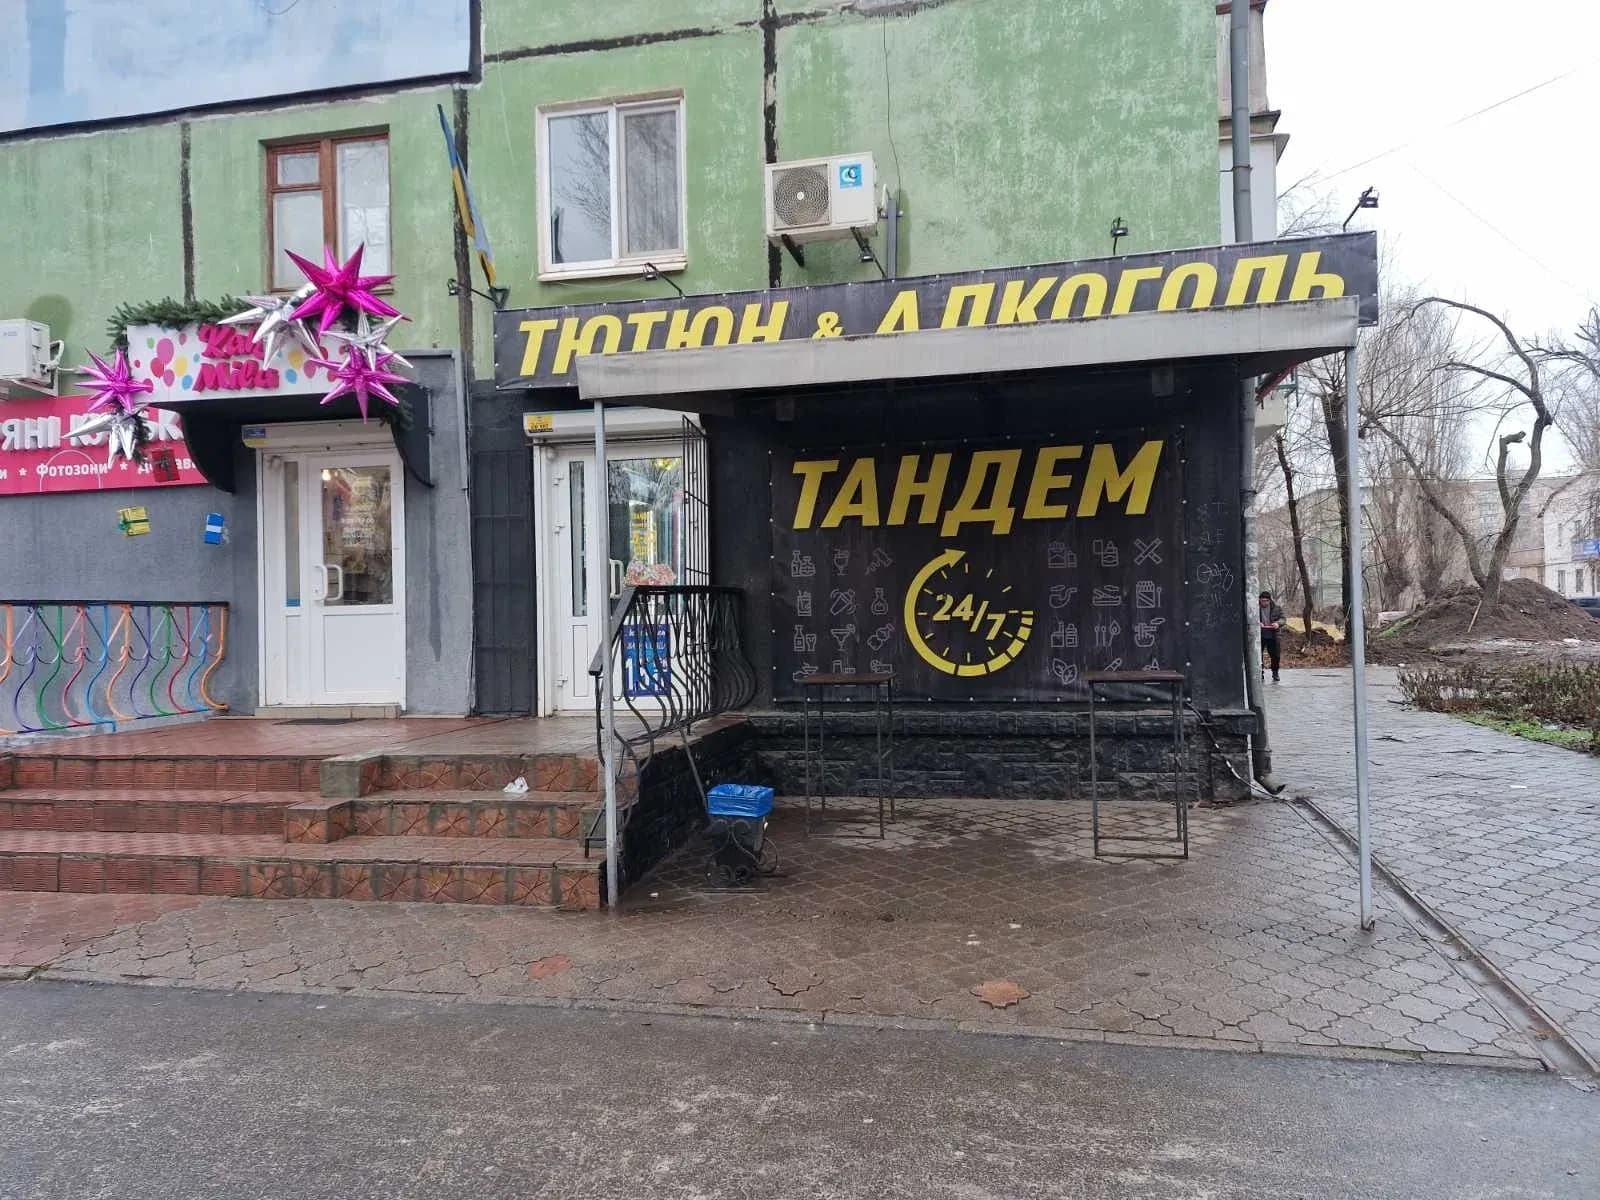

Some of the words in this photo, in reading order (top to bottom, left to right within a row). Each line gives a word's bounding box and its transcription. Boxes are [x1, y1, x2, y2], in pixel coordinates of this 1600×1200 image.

[518, 301, 789, 376] ТЮТЮН
[811, 311, 846, 340] &
[875, 251, 1345, 336] АЛКОГОЛЬ
[0, 416, 62, 451] ЯНІ
[36, 463, 108, 477] Фотозони
[792, 440, 1164, 538] ТАНДЕМ
[932, 594, 1007, 642] 24/7
